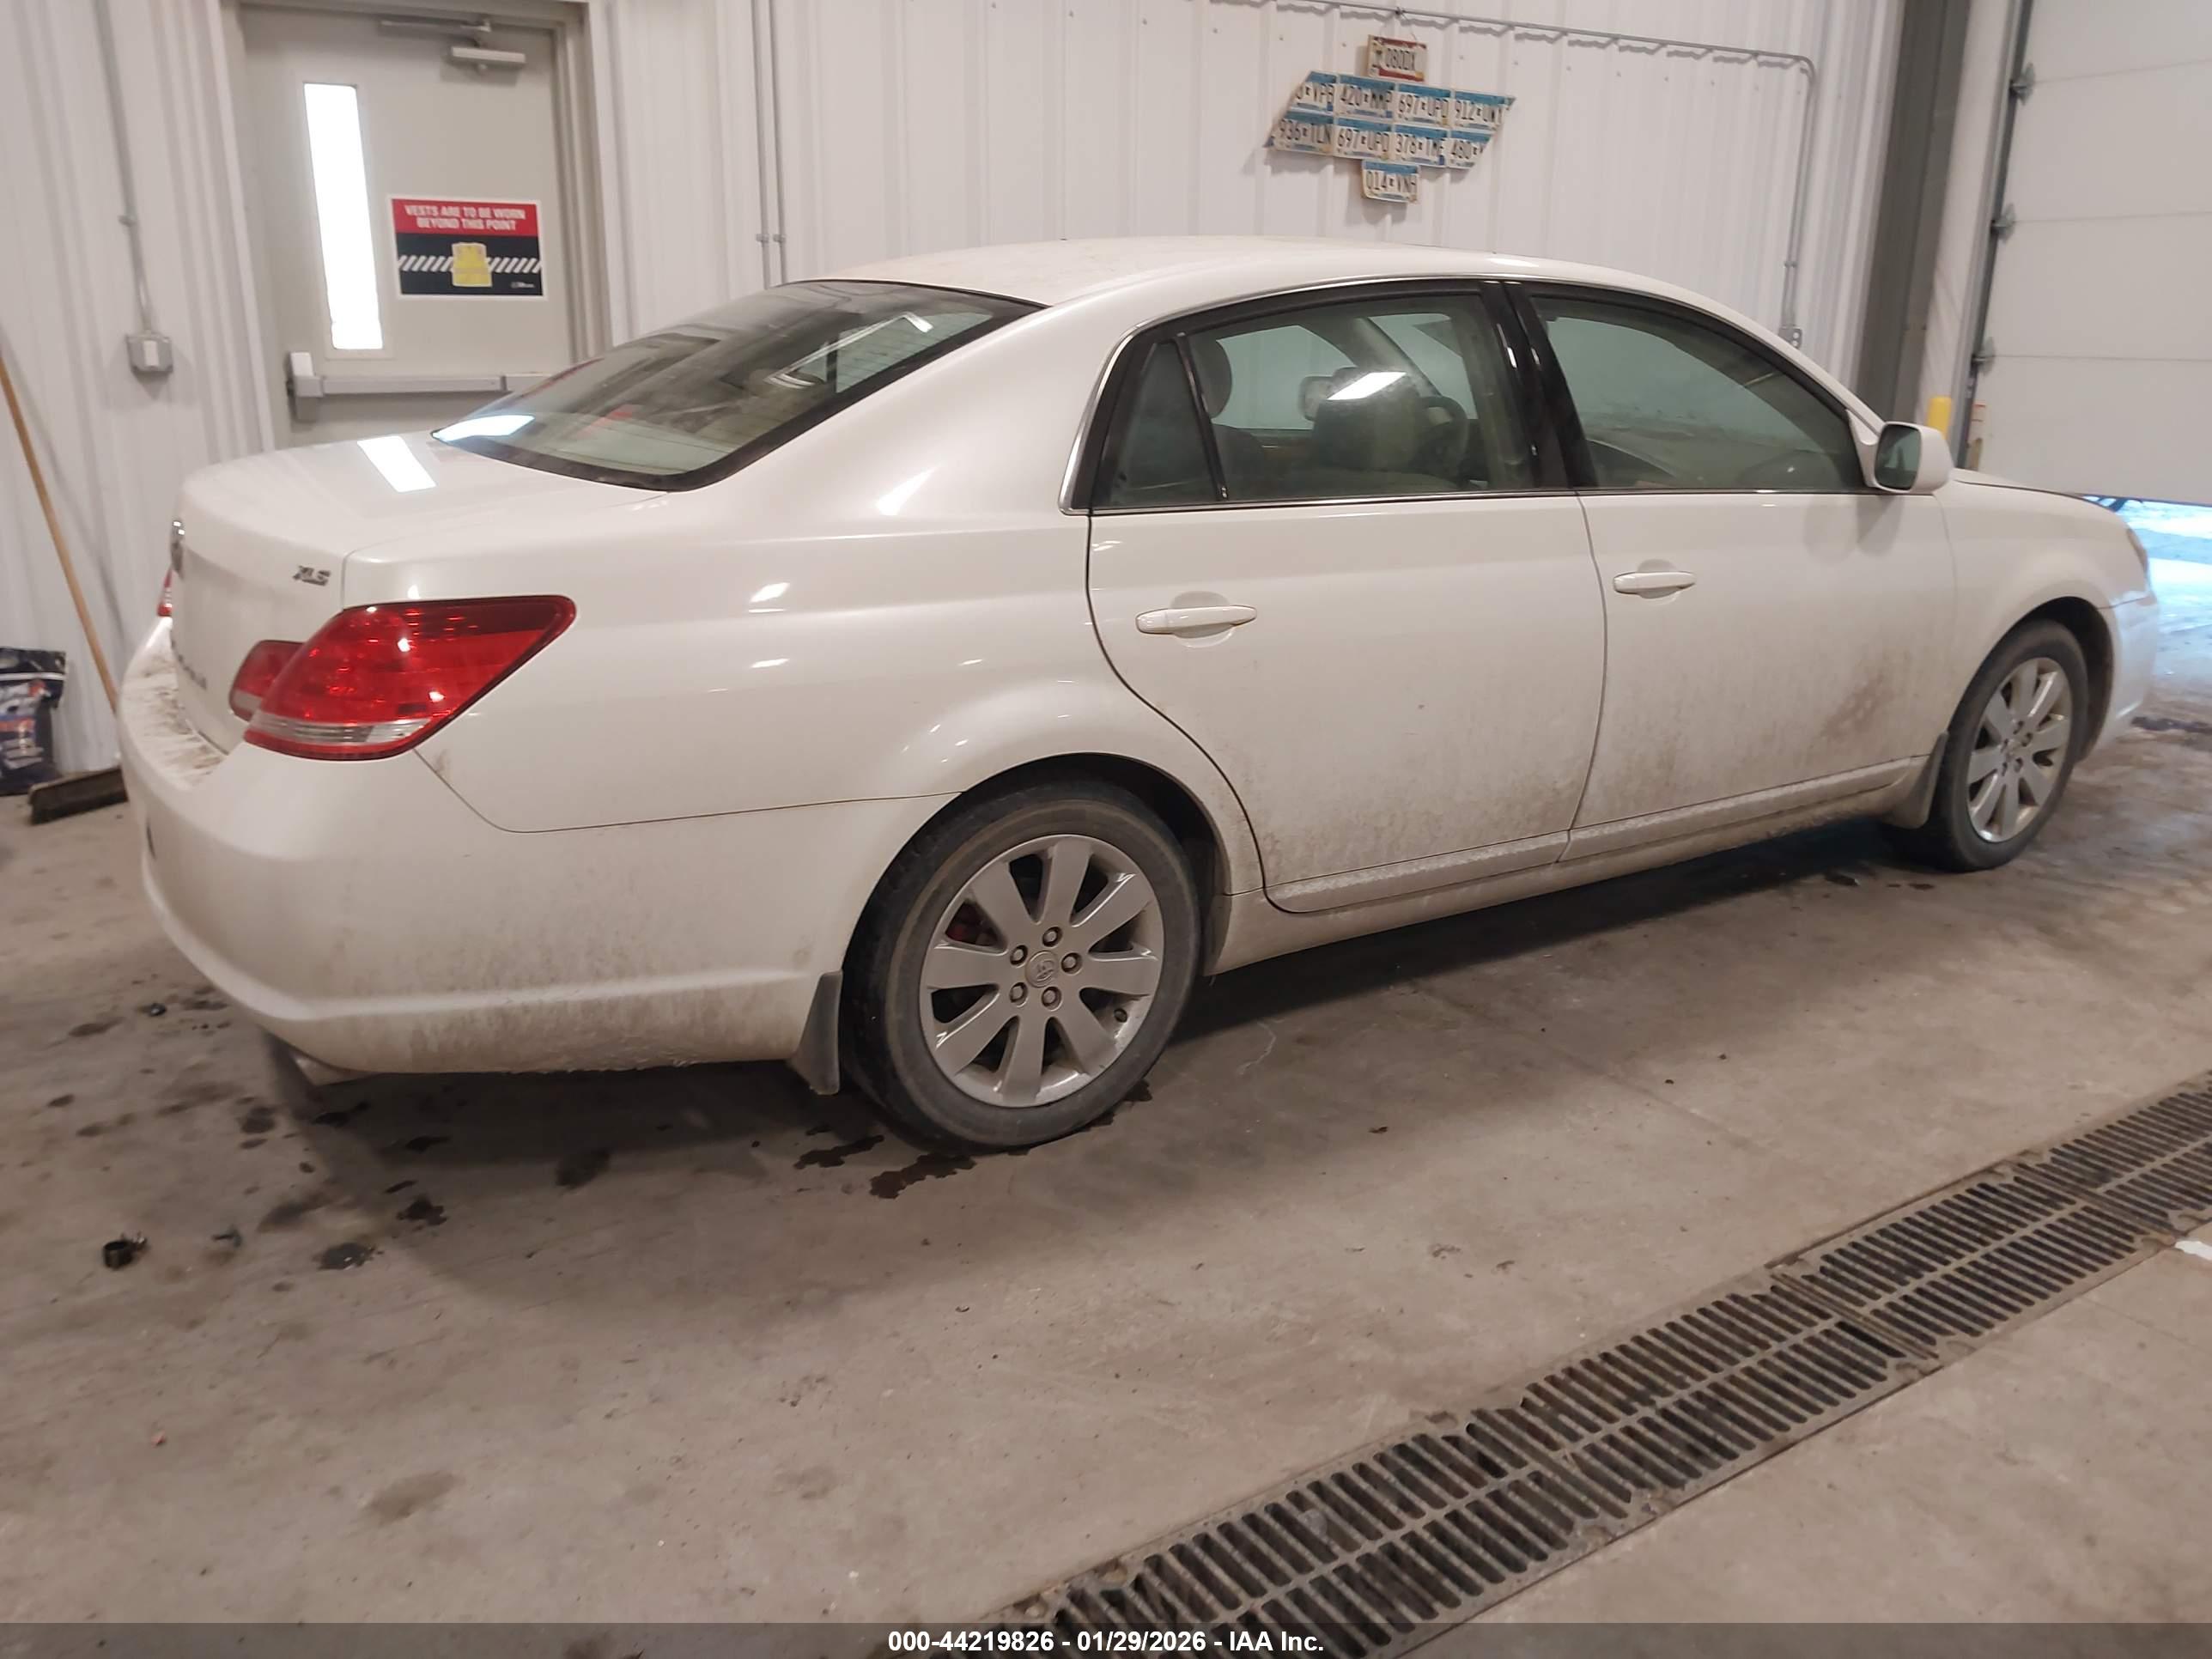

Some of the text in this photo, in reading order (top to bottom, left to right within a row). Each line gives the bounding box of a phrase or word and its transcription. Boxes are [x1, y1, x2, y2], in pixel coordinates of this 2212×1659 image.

[404, 204, 526, 220] VESTS ARE TO BE WORN
[416, 217, 518, 231] BEYOND THIS POINT
